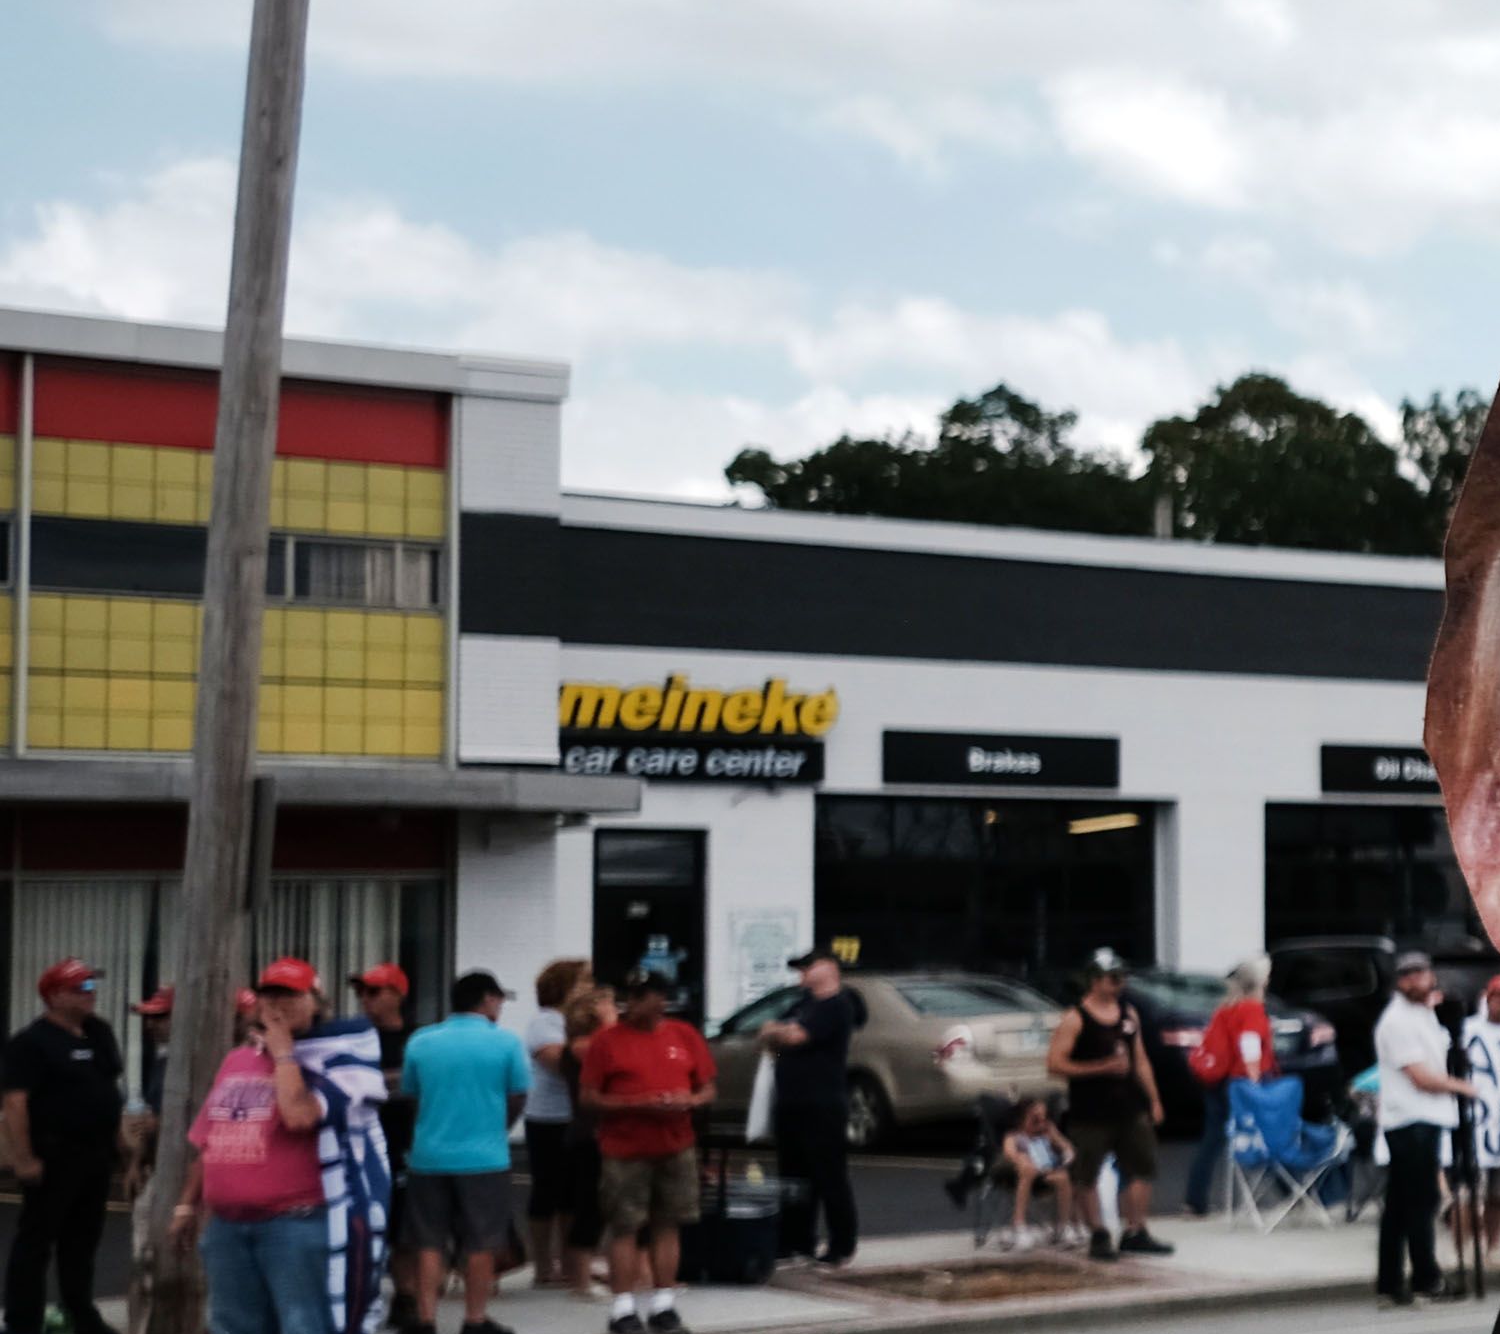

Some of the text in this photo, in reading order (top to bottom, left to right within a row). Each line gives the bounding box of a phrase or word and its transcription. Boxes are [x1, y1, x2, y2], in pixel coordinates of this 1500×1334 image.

[559, 672, 838, 736] meineke
[565, 745, 806, 777] car care center
[968, 746, 1042, 774] Brakes
